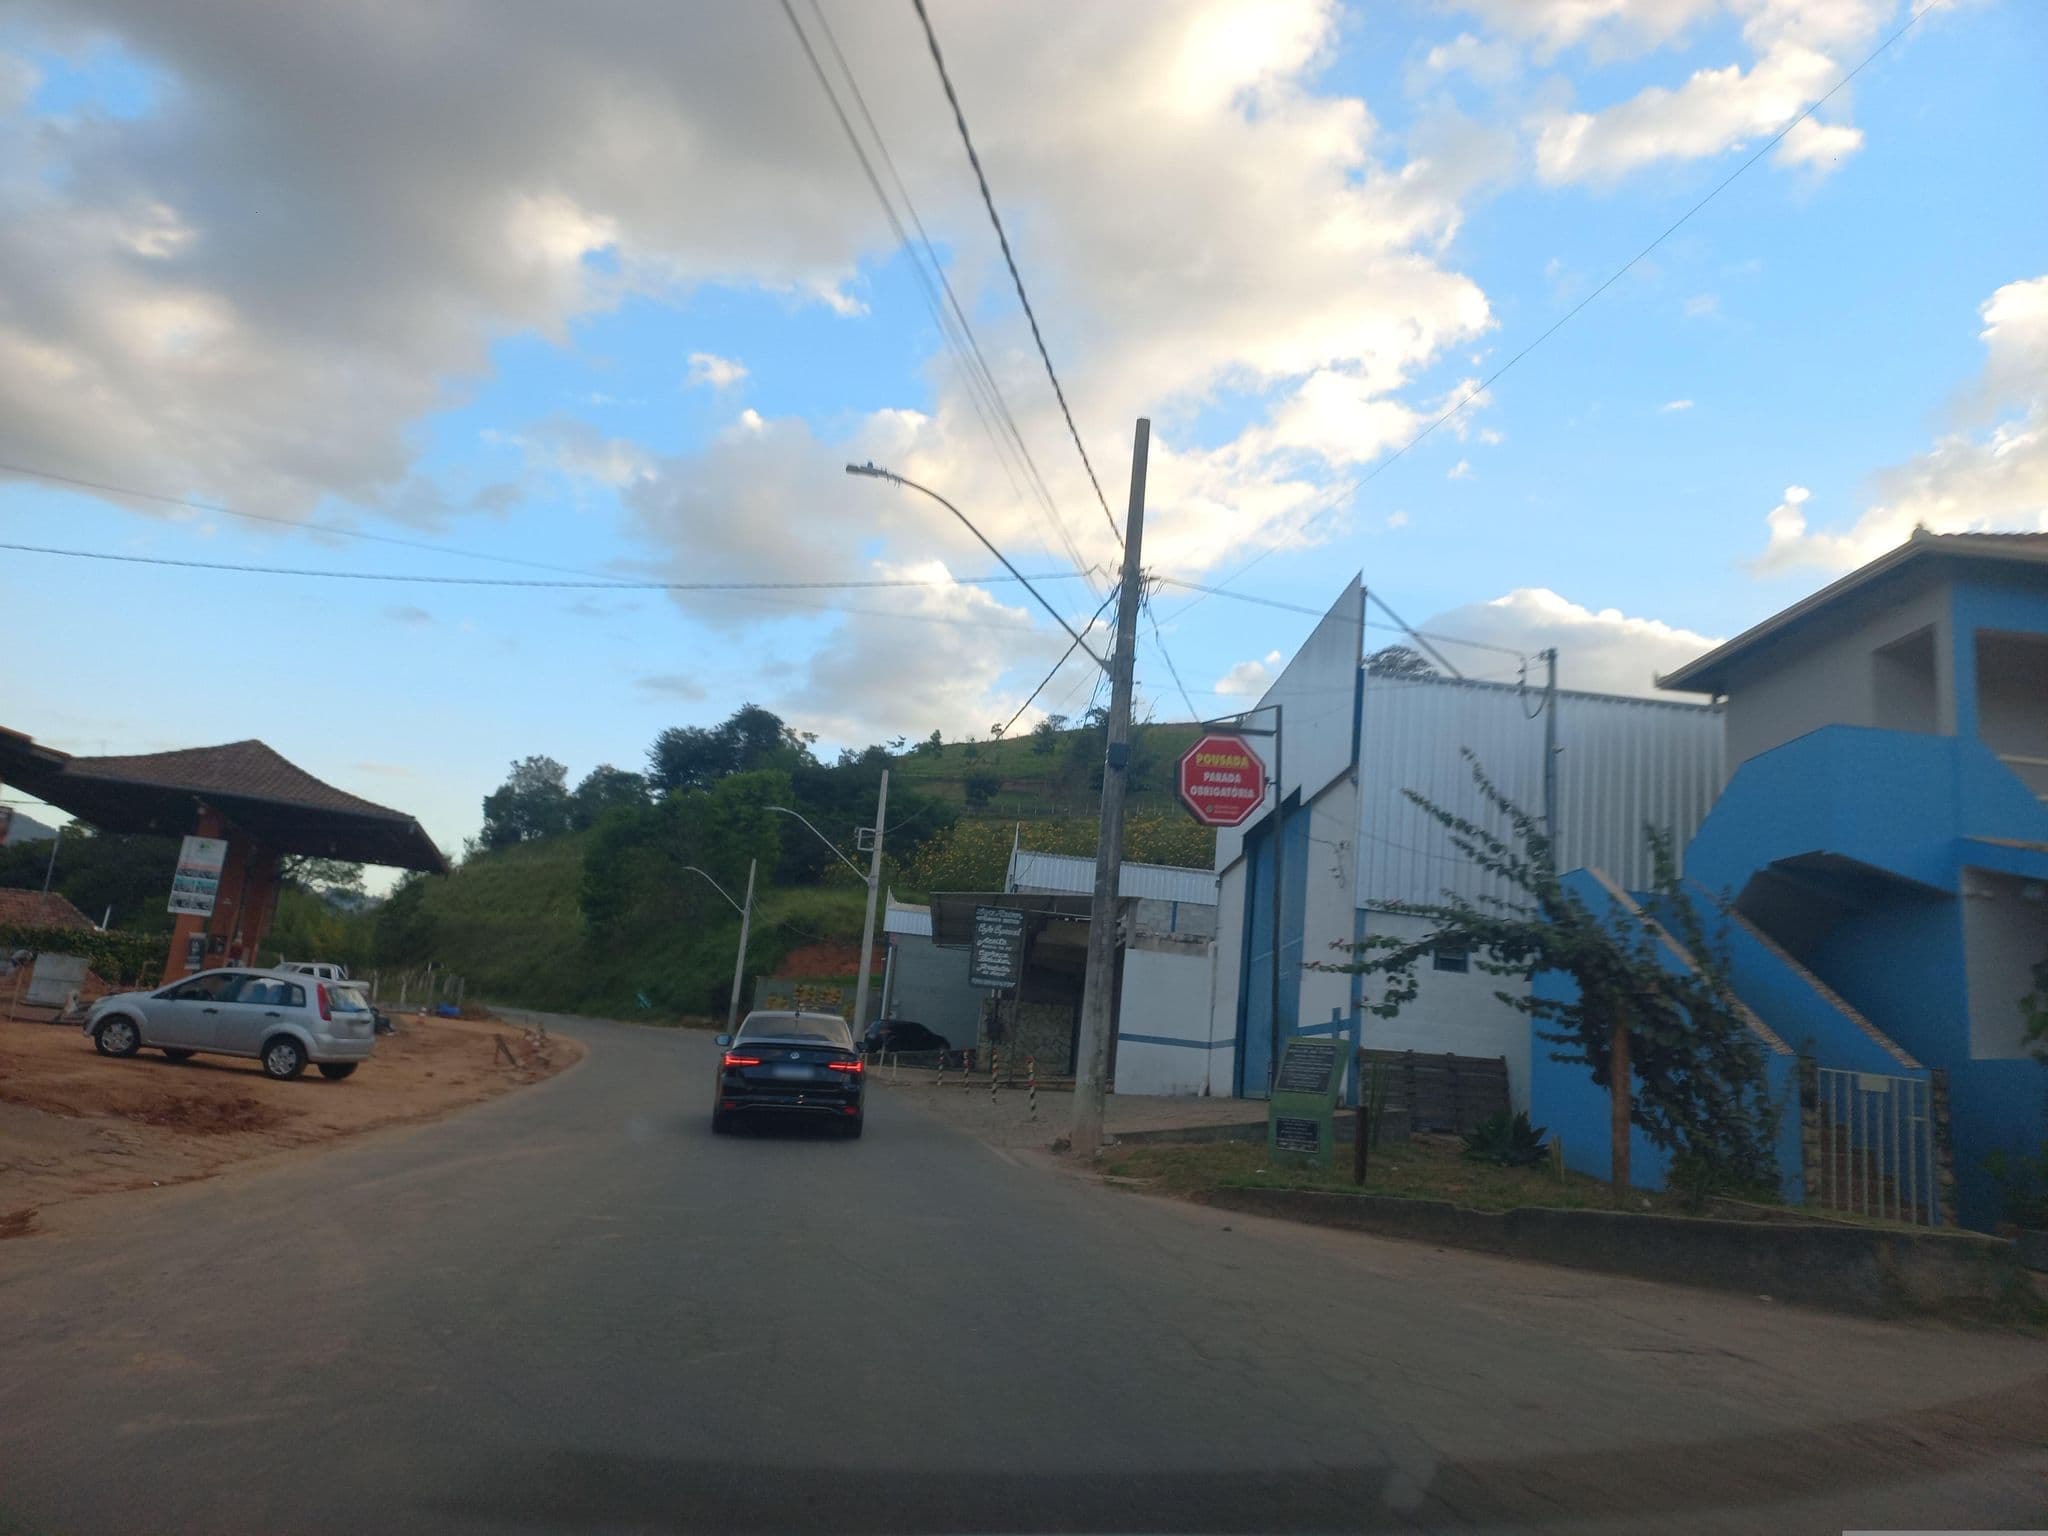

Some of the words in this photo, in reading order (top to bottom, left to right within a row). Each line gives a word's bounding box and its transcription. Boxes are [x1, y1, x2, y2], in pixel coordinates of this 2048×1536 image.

[1196, 752, 1249, 769] POUSADA
[1203, 771, 1242, 783] PARADA
[1190, 784, 1255, 798] OBRIGATÓRIA
